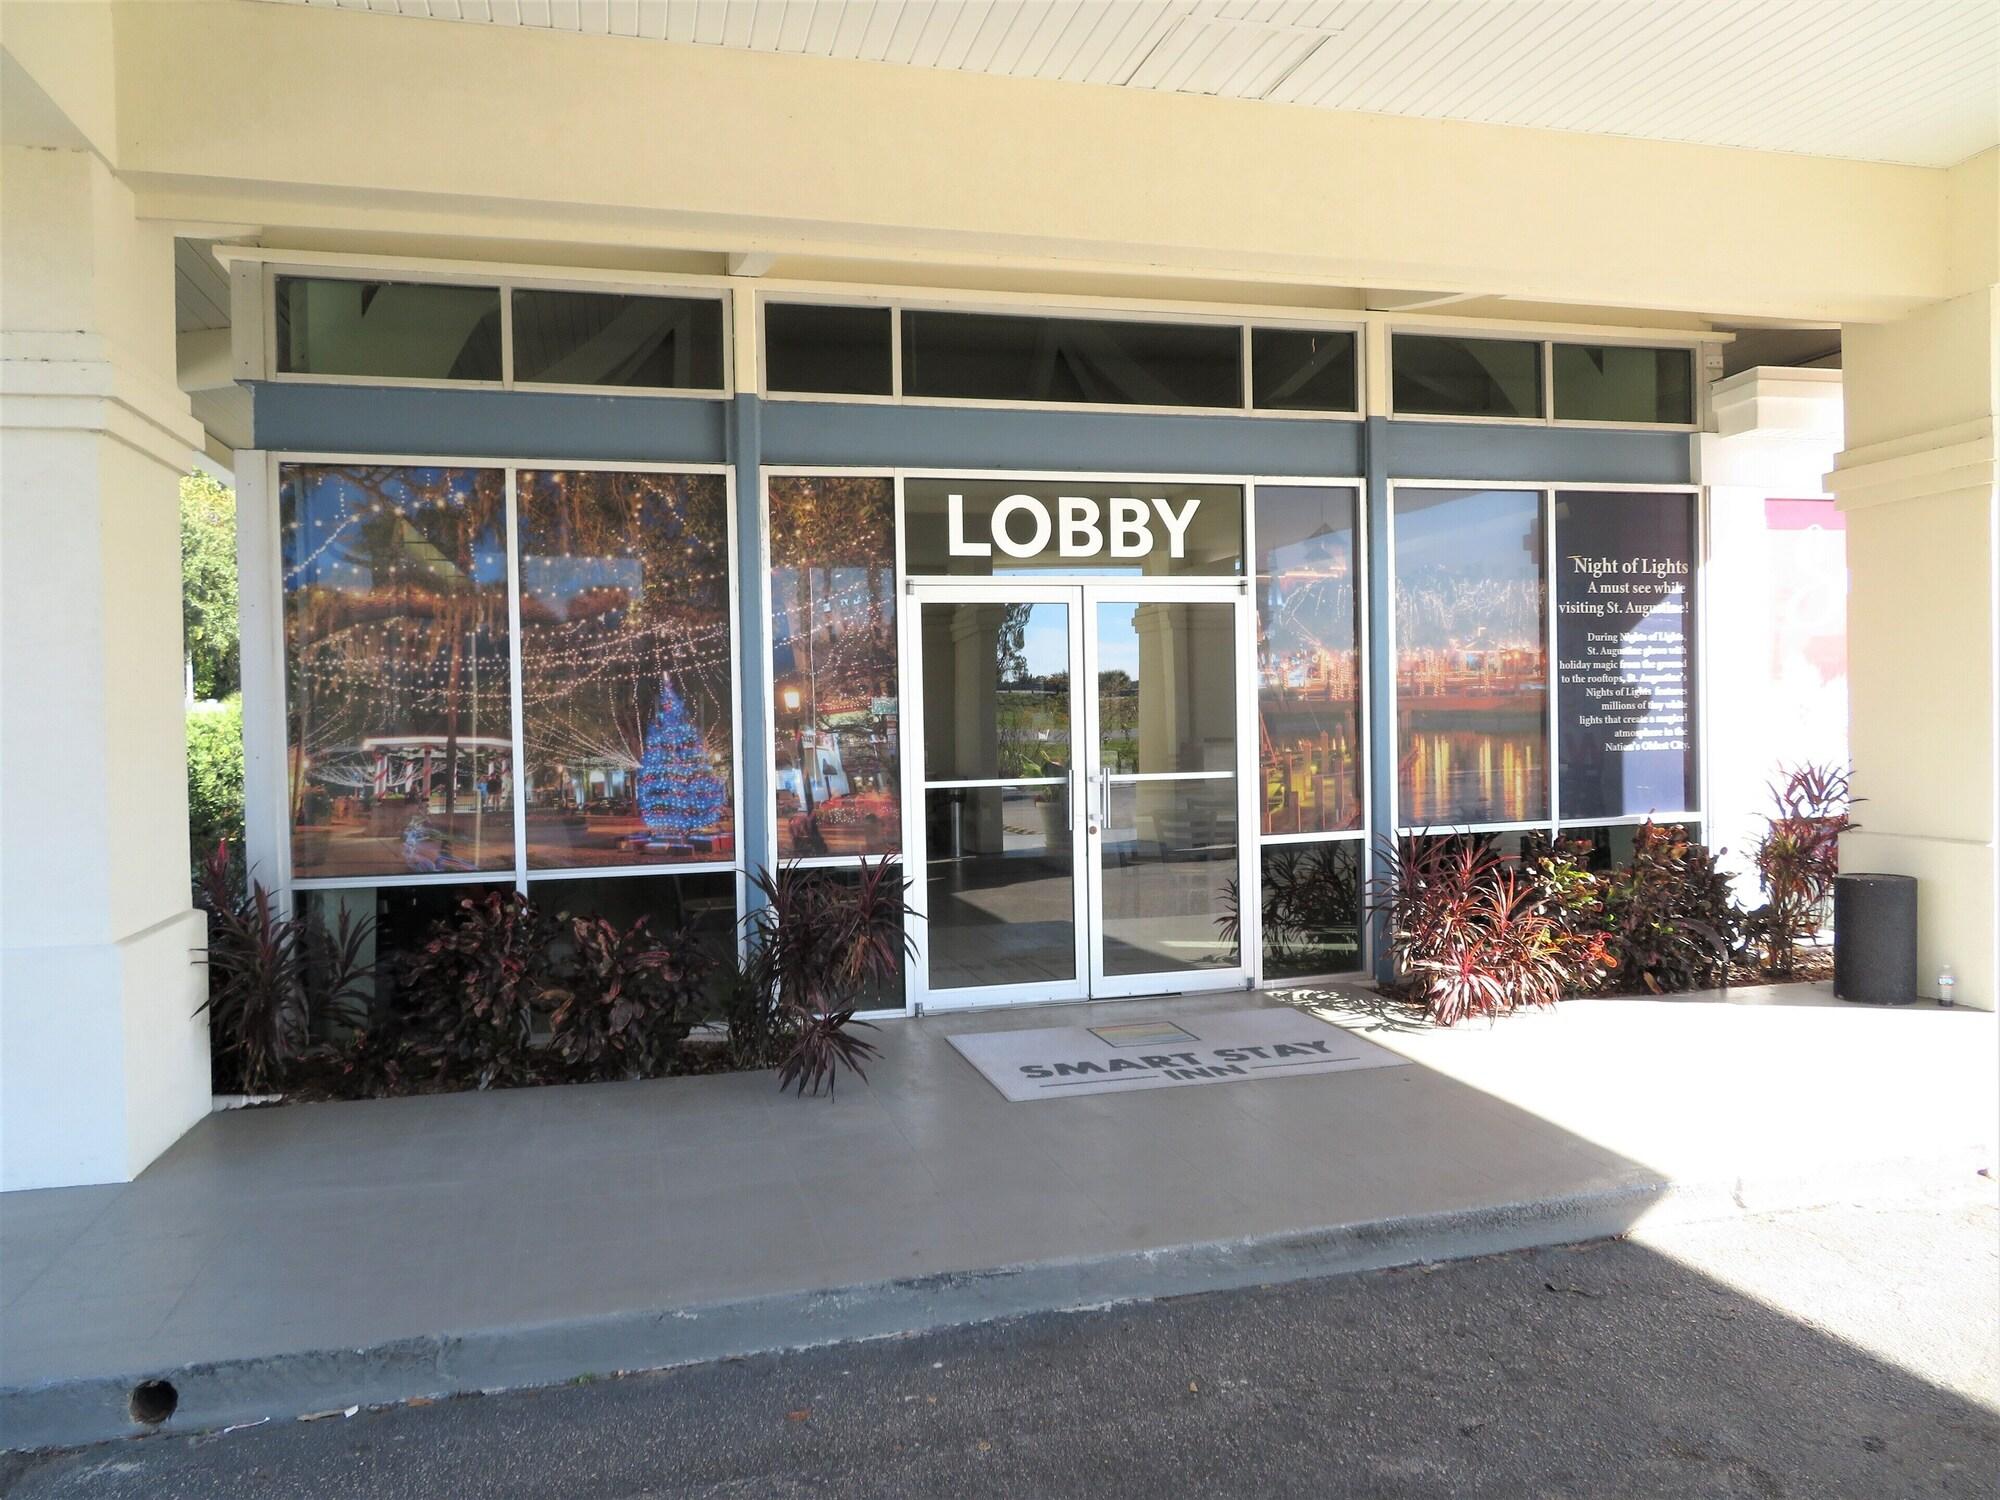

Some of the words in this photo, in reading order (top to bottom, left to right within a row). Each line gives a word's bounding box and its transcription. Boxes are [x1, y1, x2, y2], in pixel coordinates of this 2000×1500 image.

[948, 494, 1201, 558] LOBBY
[1574, 557, 1618, 578] Night
[1622, 557, 1639, 574] of
[1641, 558, 1688, 578] Lights
[1587, 581, 1597, 594] A
[1600, 583, 1630, 594] must
[1632, 584, 1651, 594] see
[1654, 581, 1686, 594] while
[1559, 601, 1604, 617] visiting
[1607, 601, 1623, 613] St.
[1587, 632, 1618, 643] During
[1587, 646, 1599, 655] St.
[1559, 660, 1591, 671] holiday
[1593, 660, 1618, 671] magic
[1561, 675, 1570, 683] to
[1572, 674, 1586, 683] the
[1587, 674, 1626, 685] rooftops,
[1586, 688, 1614, 699] Nights
[1615, 687, 1625, 696] of
[1626, 687, 1652, 698] Lights
[1601, 701, 1636, 710] millions
[1637, 701, 1647, 709] of
[1579, 715, 1603, 727] lights
[1605, 715, 1621, 724] that
[1623, 715, 1648, 724] create
[1019, 1052, 1202, 1078] SMART
[1213, 1040, 1332, 1062] STAY
[1163, 1064, 1248, 1081] INN
